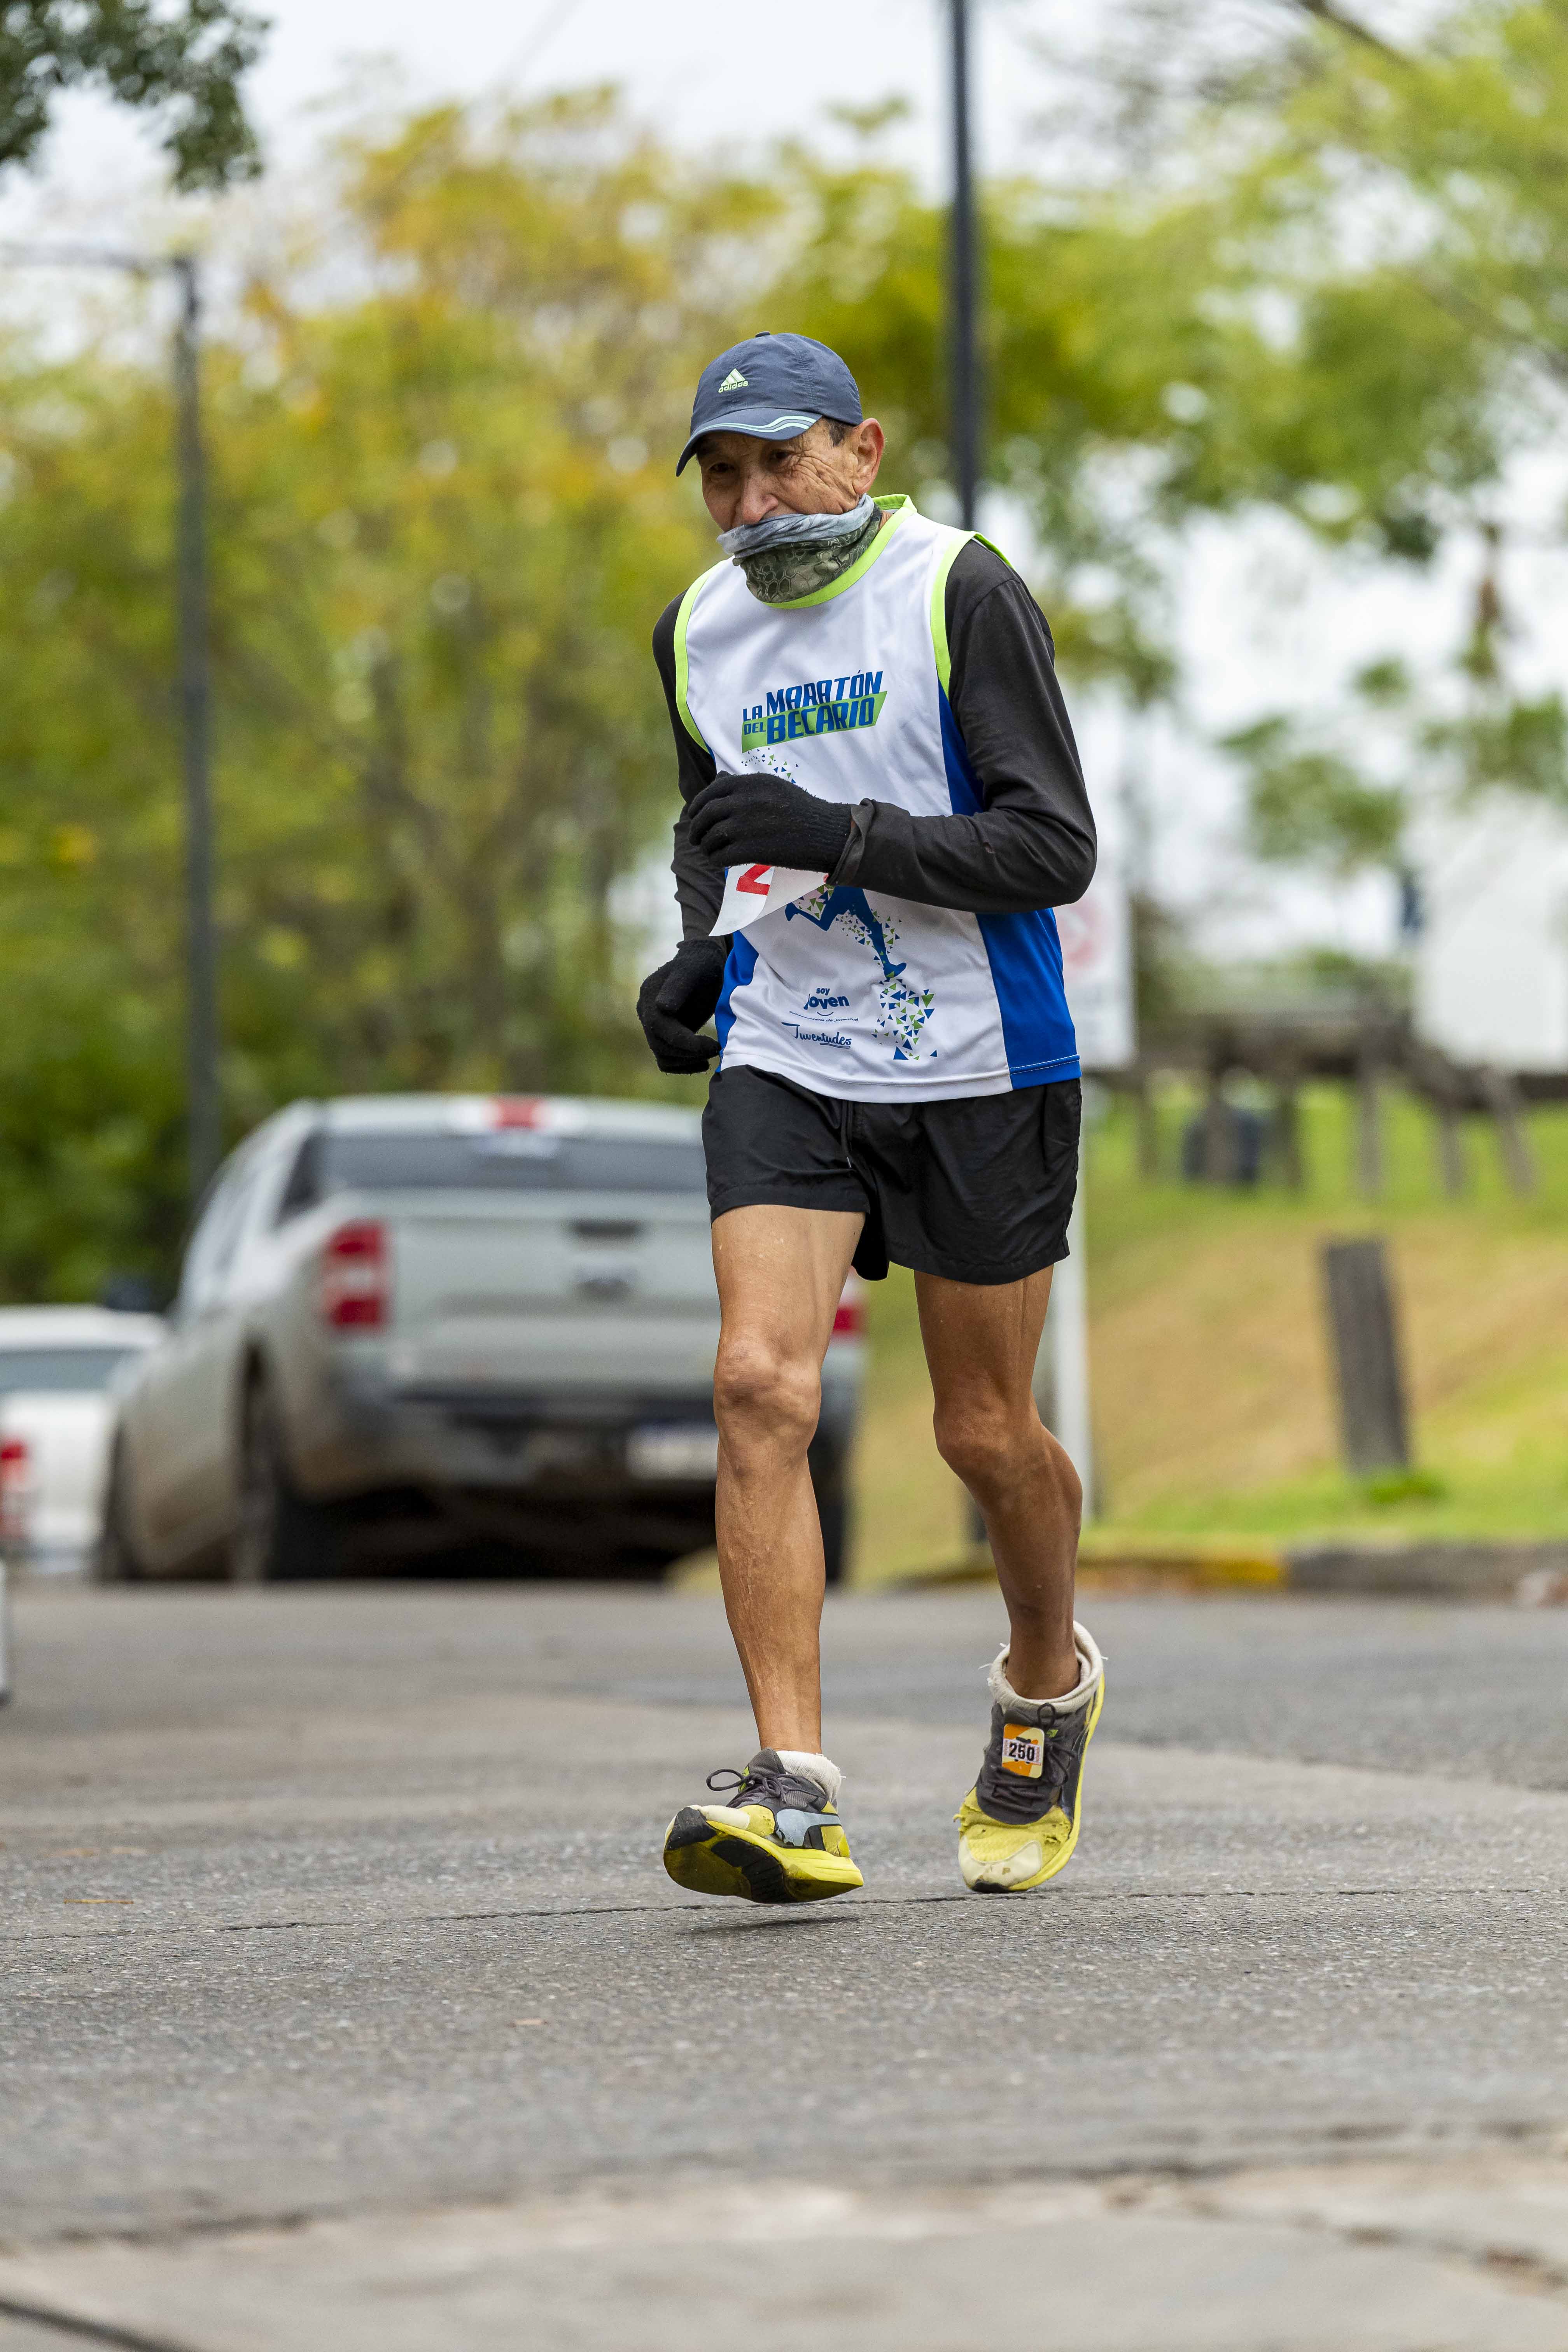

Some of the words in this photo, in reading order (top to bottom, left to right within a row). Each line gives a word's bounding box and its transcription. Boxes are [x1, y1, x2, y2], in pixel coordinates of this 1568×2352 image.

[718, 381, 748, 393] adidas
[743, 705, 763, 722] LA
[766, 670, 883, 716] MARATÓN
[744, 722, 766, 735] DEL
[766, 697, 875, 744] BECARIO
[1008, 1743, 1035, 1761] 250
